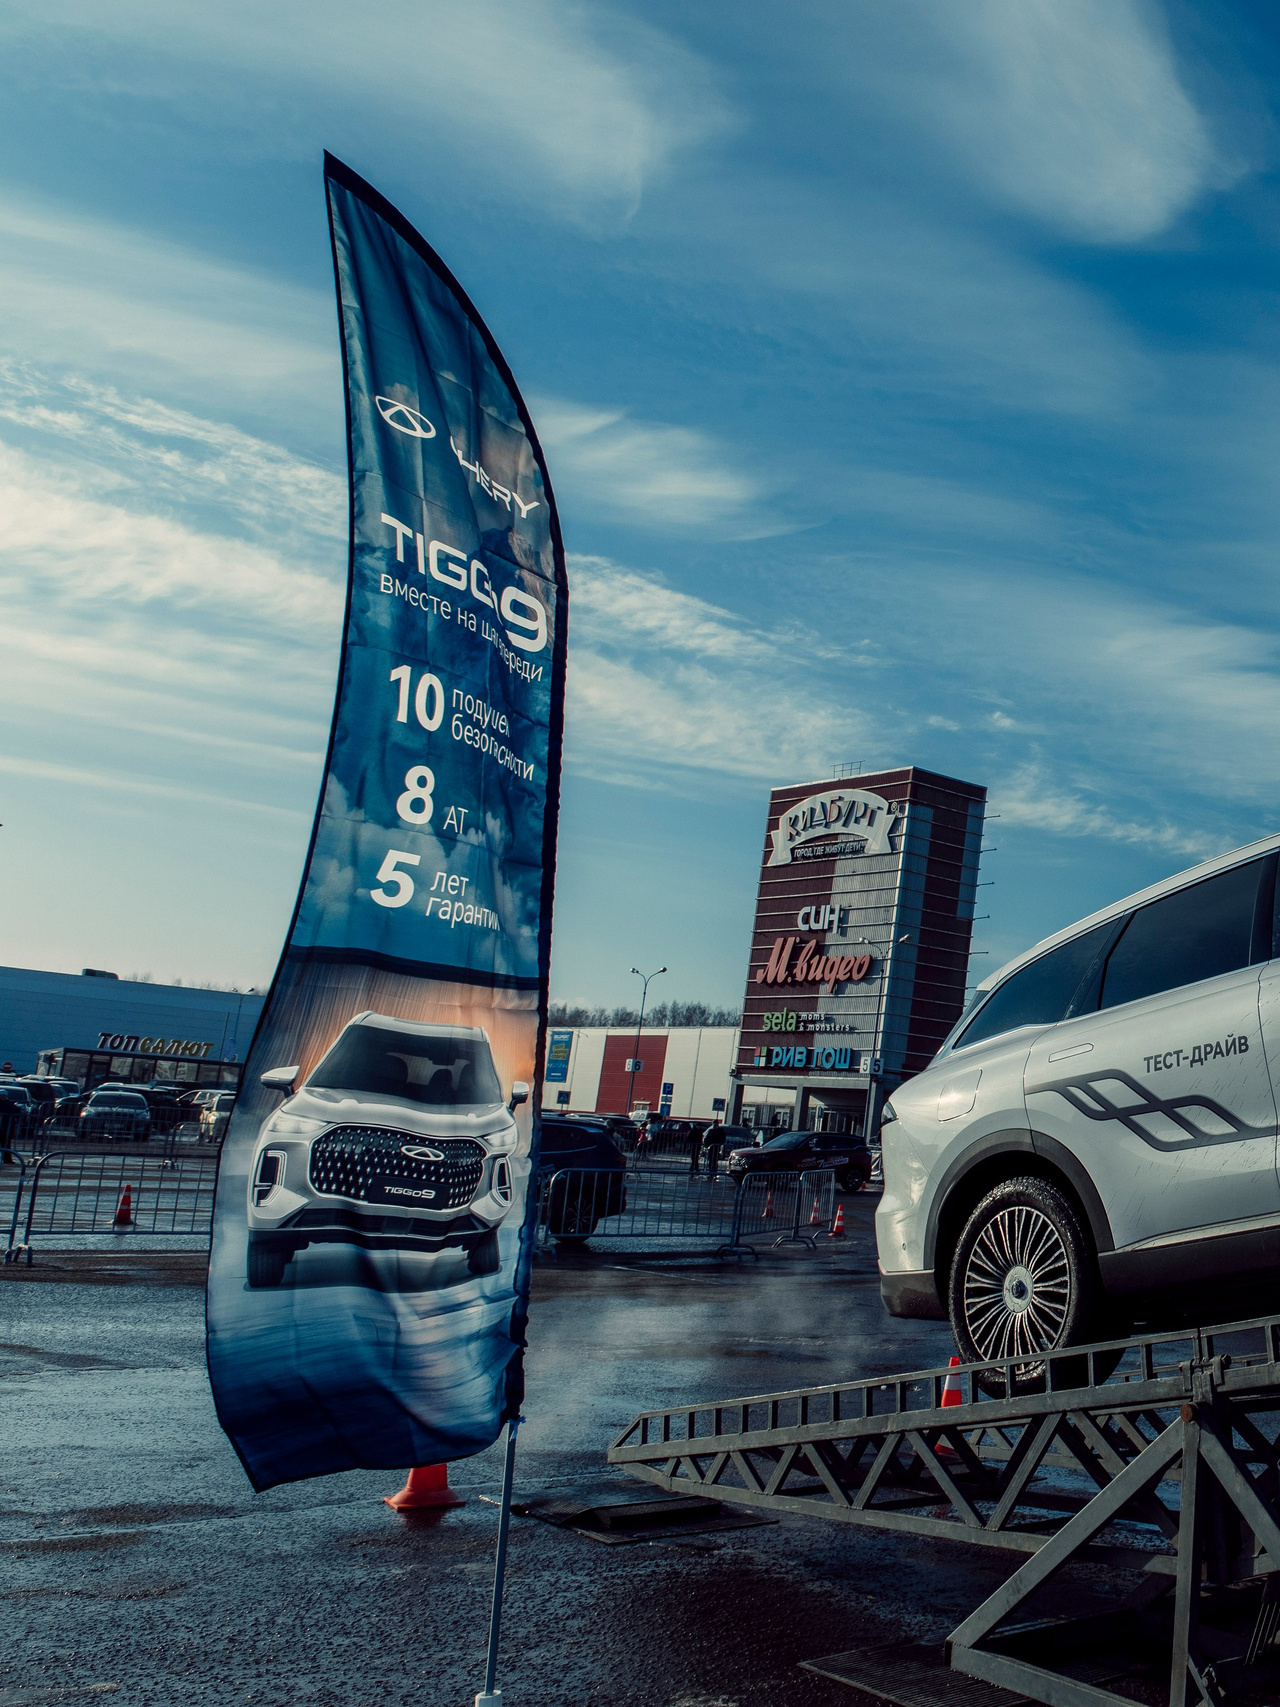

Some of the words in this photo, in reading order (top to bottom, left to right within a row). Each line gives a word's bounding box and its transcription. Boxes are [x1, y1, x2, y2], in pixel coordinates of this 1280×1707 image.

[457, 606, 477, 633] на
[389, 664, 445, 732] 10
[396, 764, 435, 825] 8
[369, 848, 422, 909] 5
[430, 871, 470, 897] лет
[425, 896, 501, 932] гарантии
[762, 1006, 797, 1032] sela
[799, 1012, 825, 1021] moms
[808, 1022, 850, 1032] monsters
[635, 1060, 641, 1071] 6
[772, 1046, 807, 1068] РИВ
[812, 1046, 852, 1069] ГОШ
[861, 1057, 869, 1072] 5
[872, 1058, 881, 1073] 5
[1143, 1033, 1250, 1073] ТЕСТ-ДРАЙВ
[384, 1186, 436, 1199] TIGGO9
